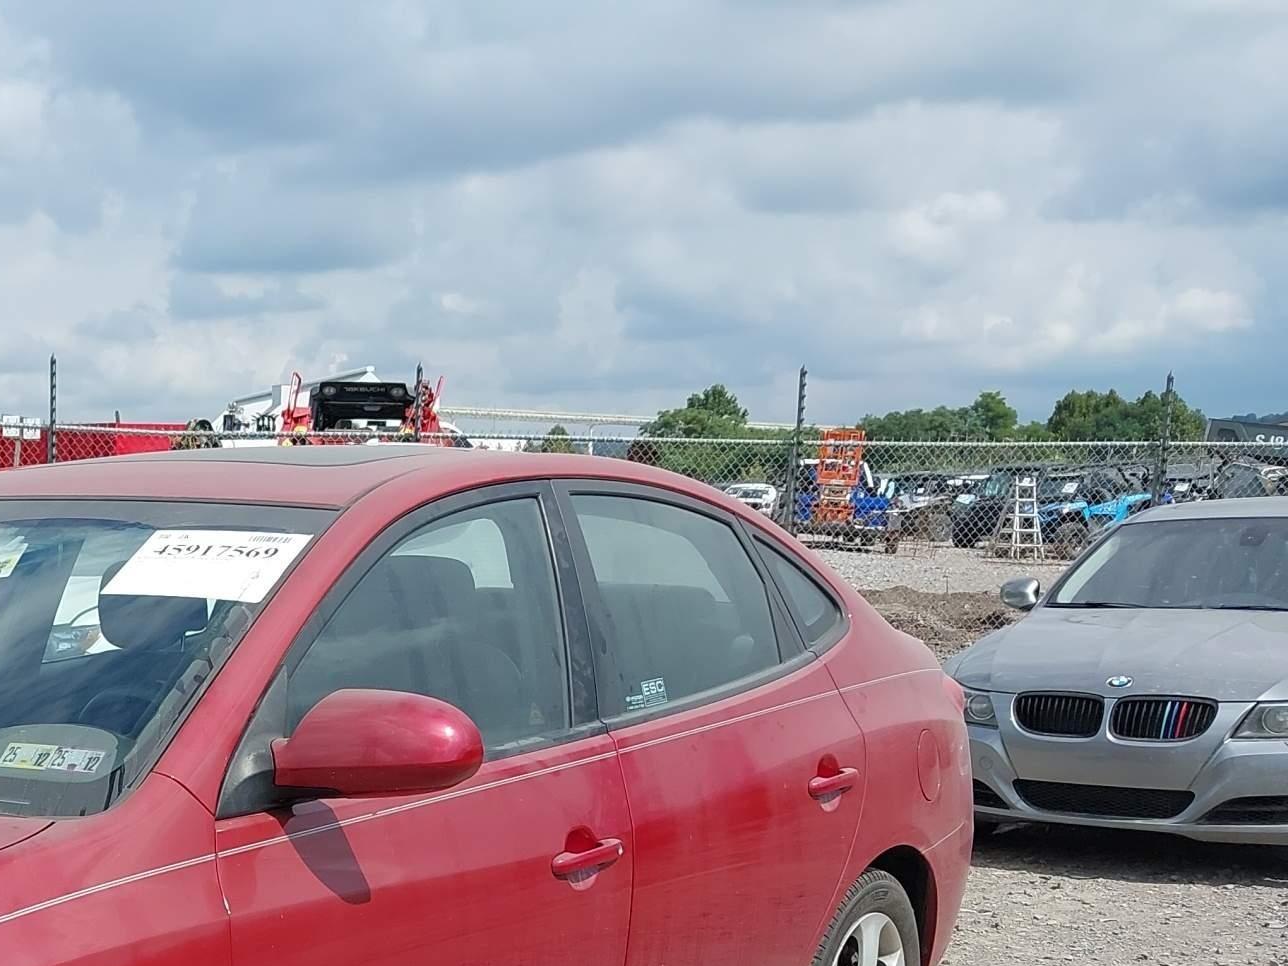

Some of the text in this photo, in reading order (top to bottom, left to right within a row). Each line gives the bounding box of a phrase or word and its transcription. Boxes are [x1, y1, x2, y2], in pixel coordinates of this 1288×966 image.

[153, 544, 279, 559] 45917569
[642, 680, 664, 696] ESC
[3, 746, 50, 767] 25 12
[52, 749, 101, 771] 25 12
